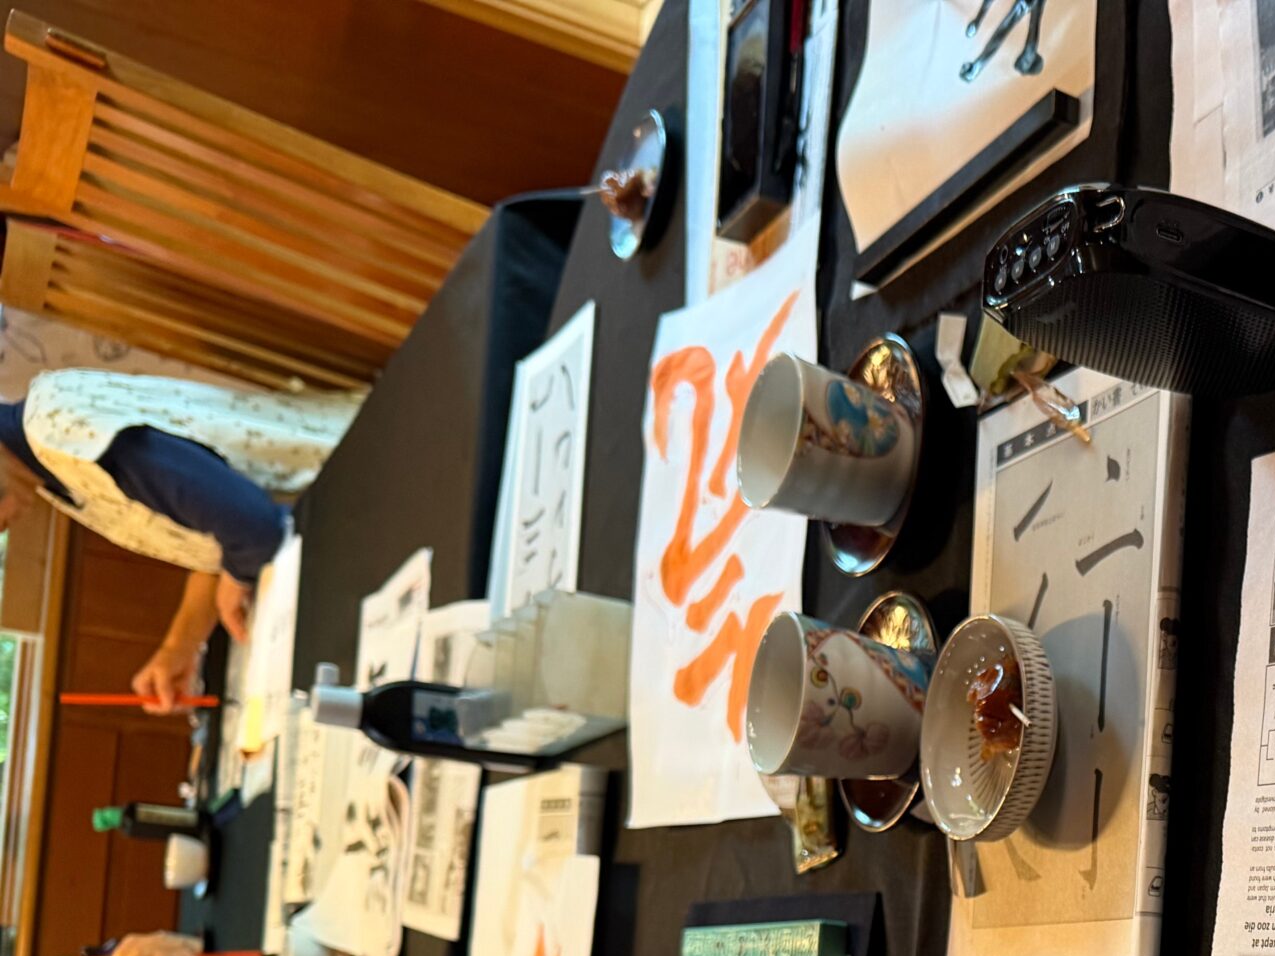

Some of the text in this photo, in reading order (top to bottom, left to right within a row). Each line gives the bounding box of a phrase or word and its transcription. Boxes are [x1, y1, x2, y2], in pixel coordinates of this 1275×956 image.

[1244, 921, 1256, 933] die
[1256, 922, 1270, 931] zoo
[1251, 938, 1260, 949] at
